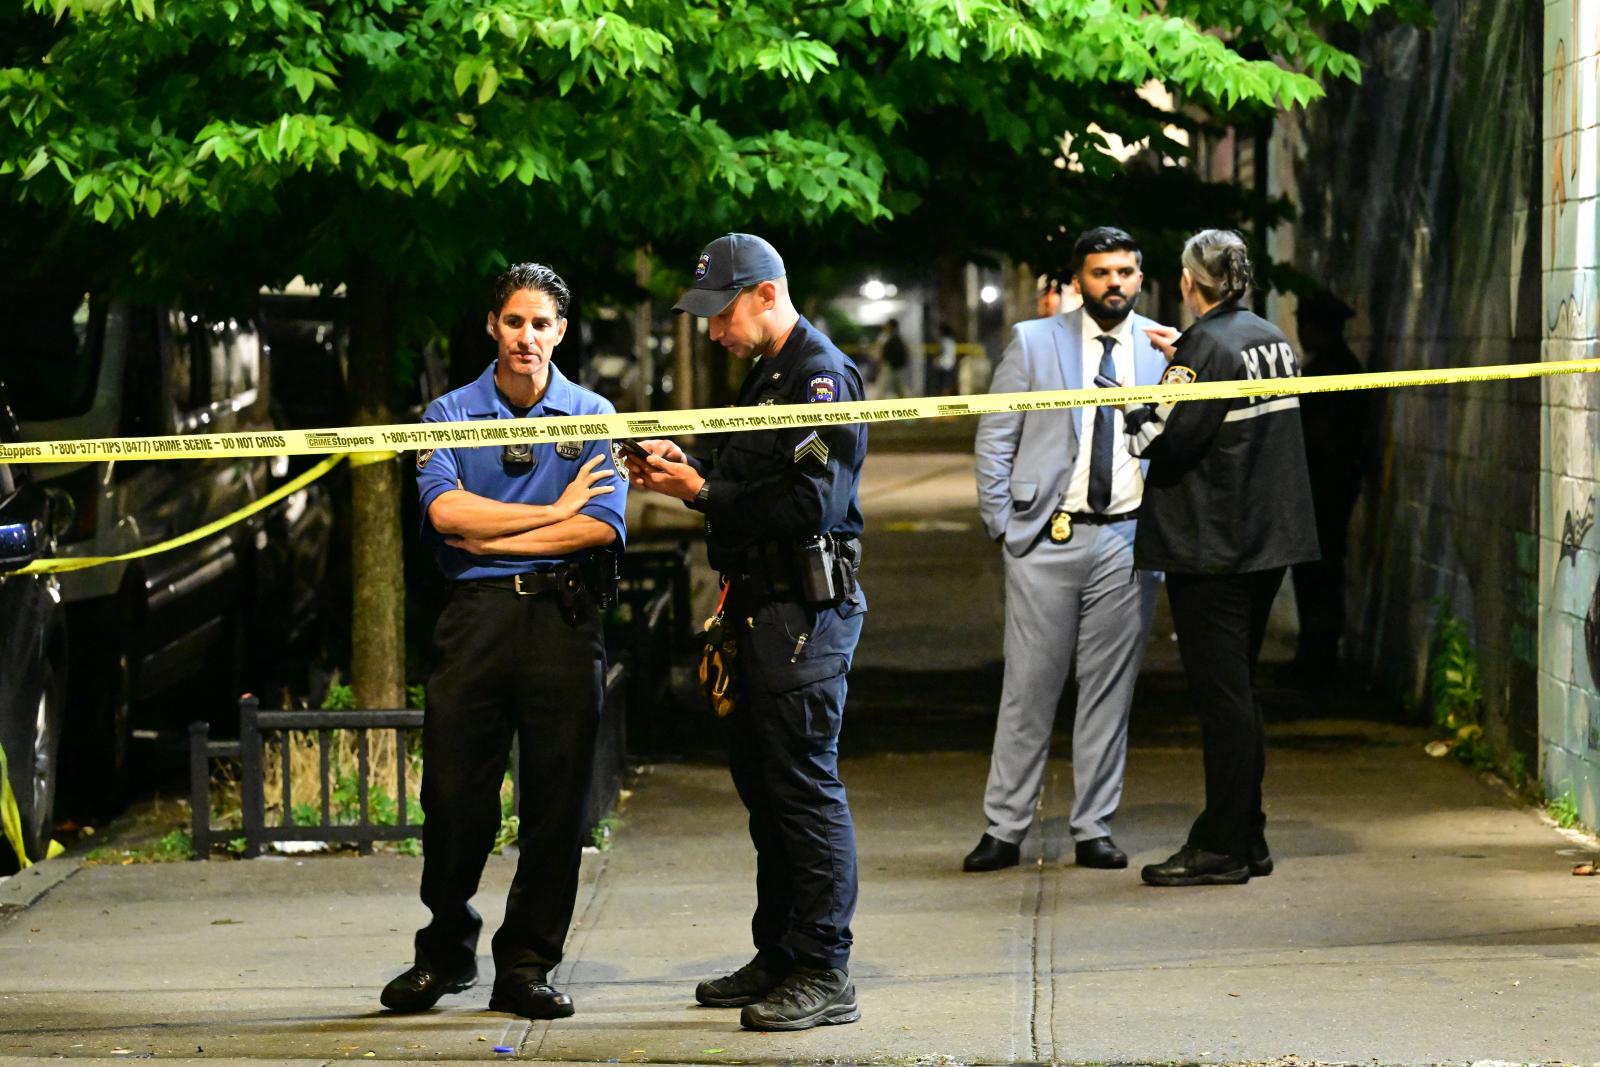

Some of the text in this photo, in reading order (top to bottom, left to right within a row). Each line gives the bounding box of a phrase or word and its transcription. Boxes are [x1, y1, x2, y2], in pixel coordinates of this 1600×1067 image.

[1241, 342, 1301, 380] NYP
[810, 377, 834, 388] POLICE
[796, 413, 823, 424] CRIME
[824, 412, 852, 422] SCENE
[381, 429, 451, 444] 1-800-577-TIPS
[451, 428, 479, 443] (8477)
[480, 427, 509, 440] CRIME
[510, 426, 539, 438] SCENE
[547, 425, 560, 437] DO
[561, 424, 579, 436] NOT
[579, 423, 610, 435] CROSS
[50, 441, 121, 456] 1-800-577-TIPS
[122, 439, 151, 454] (8477)
[152, 439, 183, 452] CRIME
[183, 438, 213, 451] SCENE
[221, 437, 235, 450] DO
[235, 436, 254, 449] NOT
[253, 435, 286, 448] CROSS
